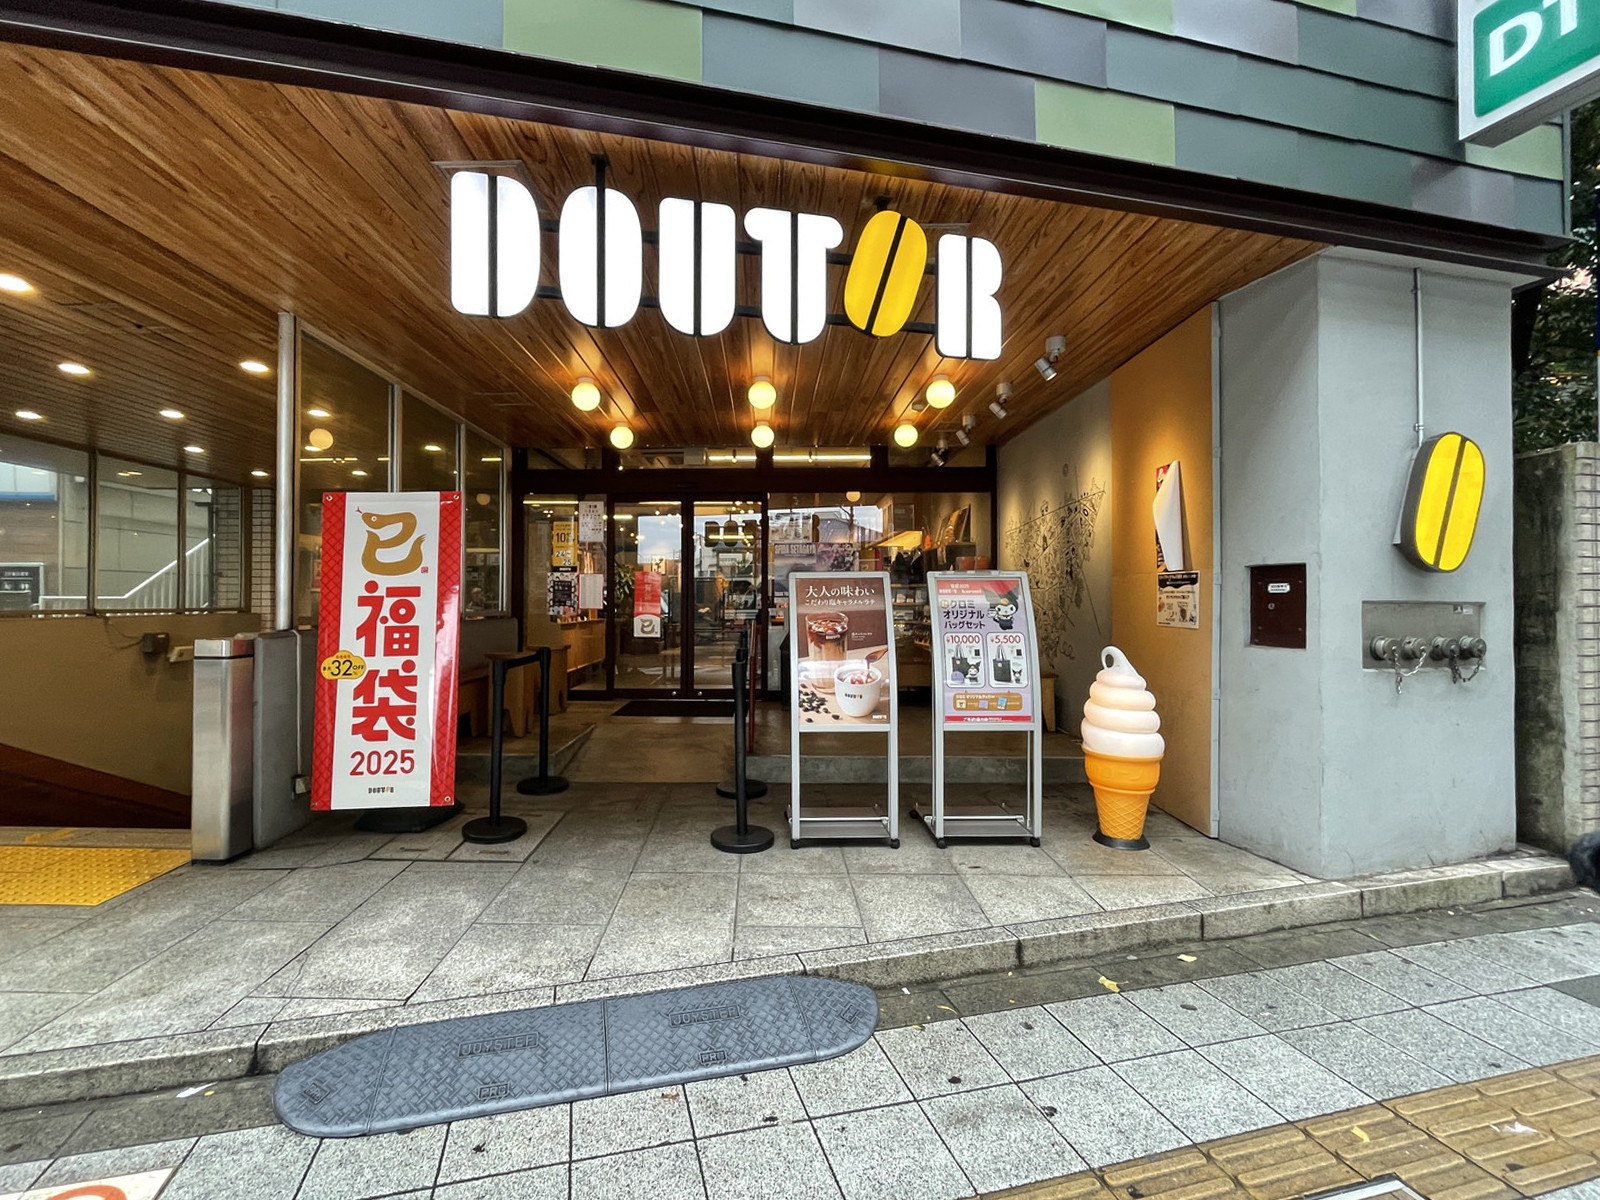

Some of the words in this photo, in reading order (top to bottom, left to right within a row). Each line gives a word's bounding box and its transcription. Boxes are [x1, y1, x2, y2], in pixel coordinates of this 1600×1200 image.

[450, 171, 1003, 360] DOUTOR
[804, 585, 875, 598] 大人の味わい
[943, 610, 985, 620] オリジナル
[944, 621, 986, 630] バッグセット
[351, 580, 422, 742] 福袋
[349, 749, 415, 777] 2025
[460, 1035, 536, 1056] JOYSTEP
